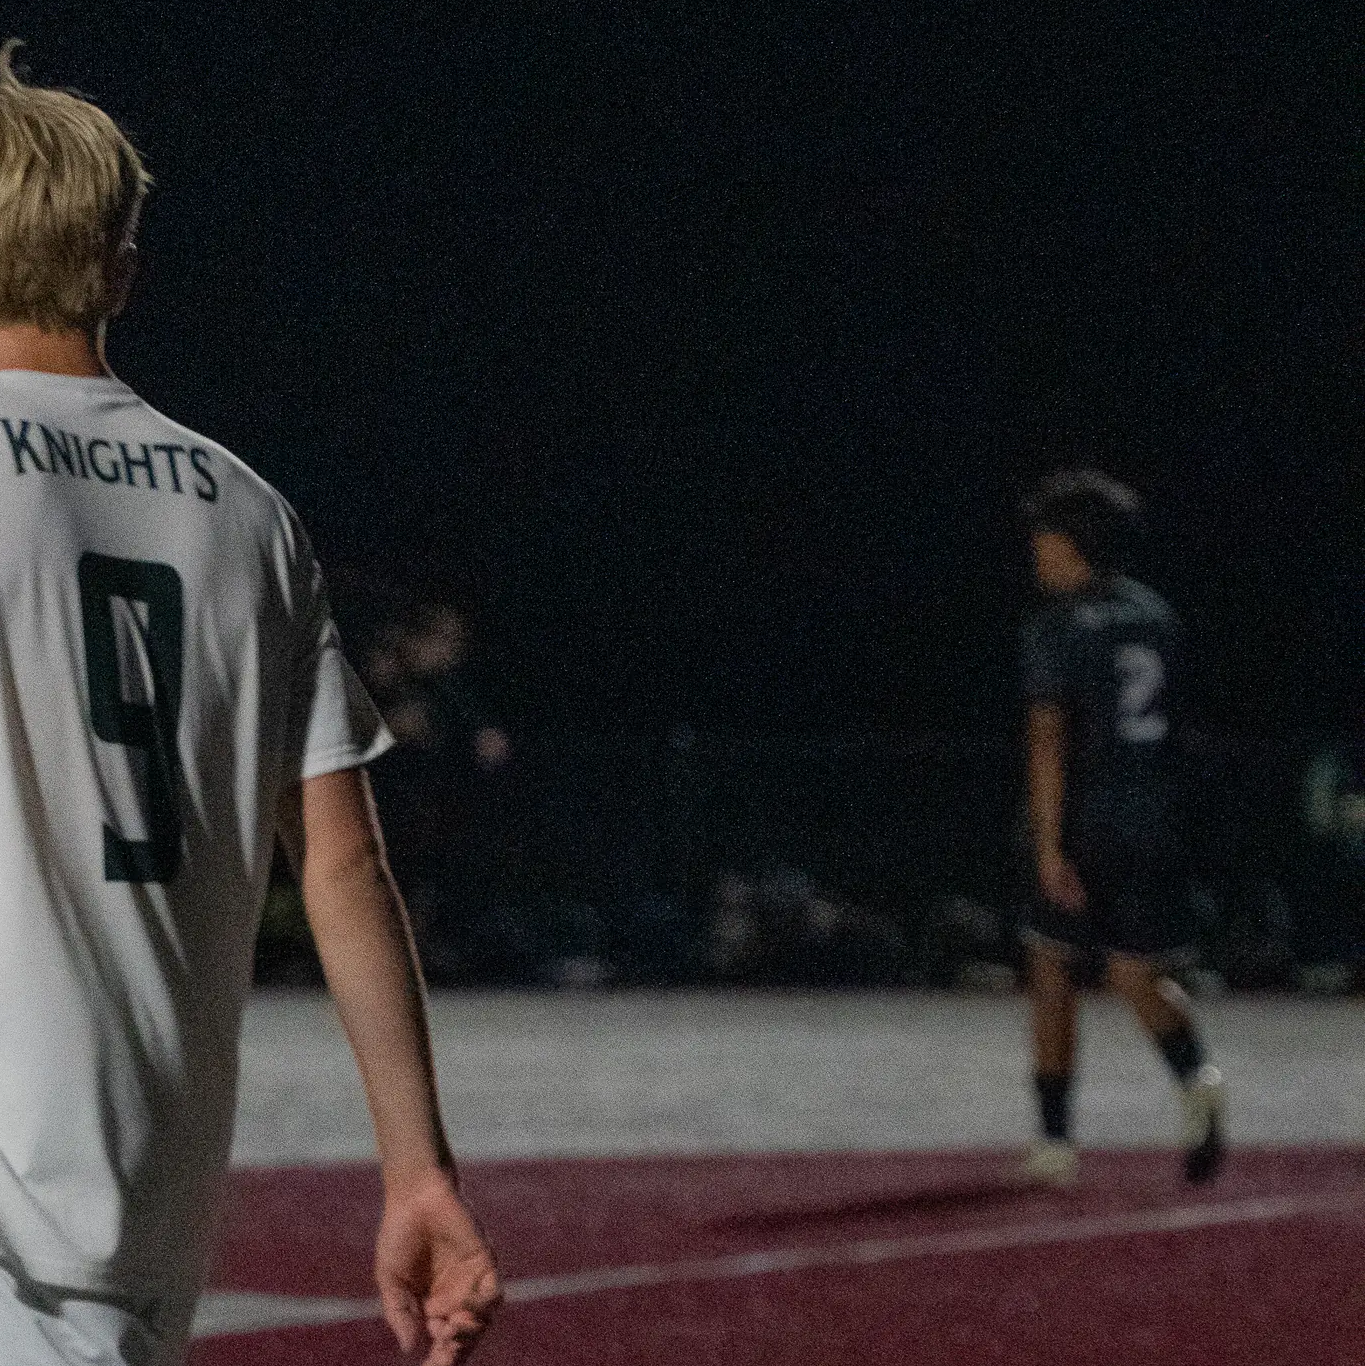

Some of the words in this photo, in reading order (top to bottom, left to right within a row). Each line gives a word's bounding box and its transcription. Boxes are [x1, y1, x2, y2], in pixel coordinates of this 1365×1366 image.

[0, 418, 218, 502] KNIGHTS
[78, 552, 183, 883] 9
[1115, 644, 1169, 742] 2
